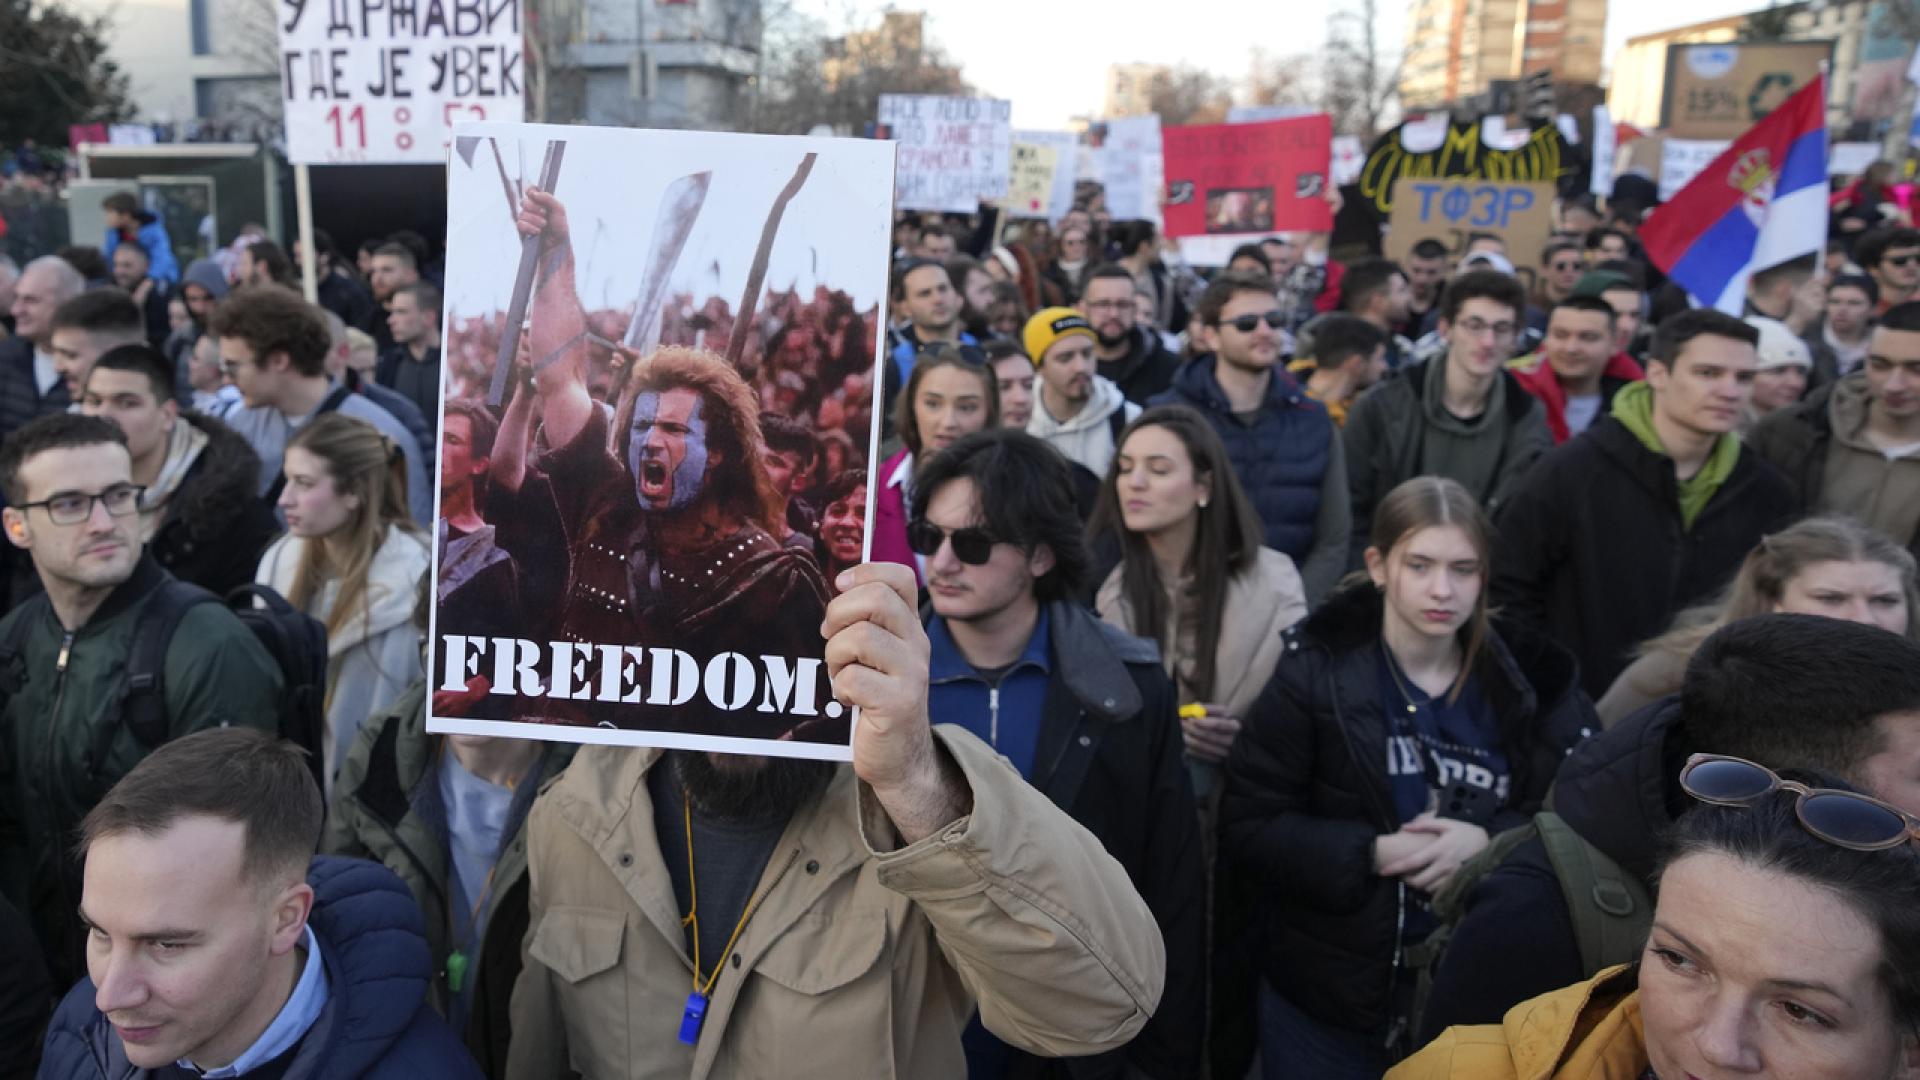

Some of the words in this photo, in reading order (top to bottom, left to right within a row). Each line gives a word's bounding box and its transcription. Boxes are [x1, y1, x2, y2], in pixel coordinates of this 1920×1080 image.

[284, 0, 307, 33] У
[327, 0, 519, 39] ДРЖАВИ
[285, 48, 350, 99] ГДЕ
[367, 47, 413, 98] ЈЕ
[429, 46, 521, 97] УВЕК
